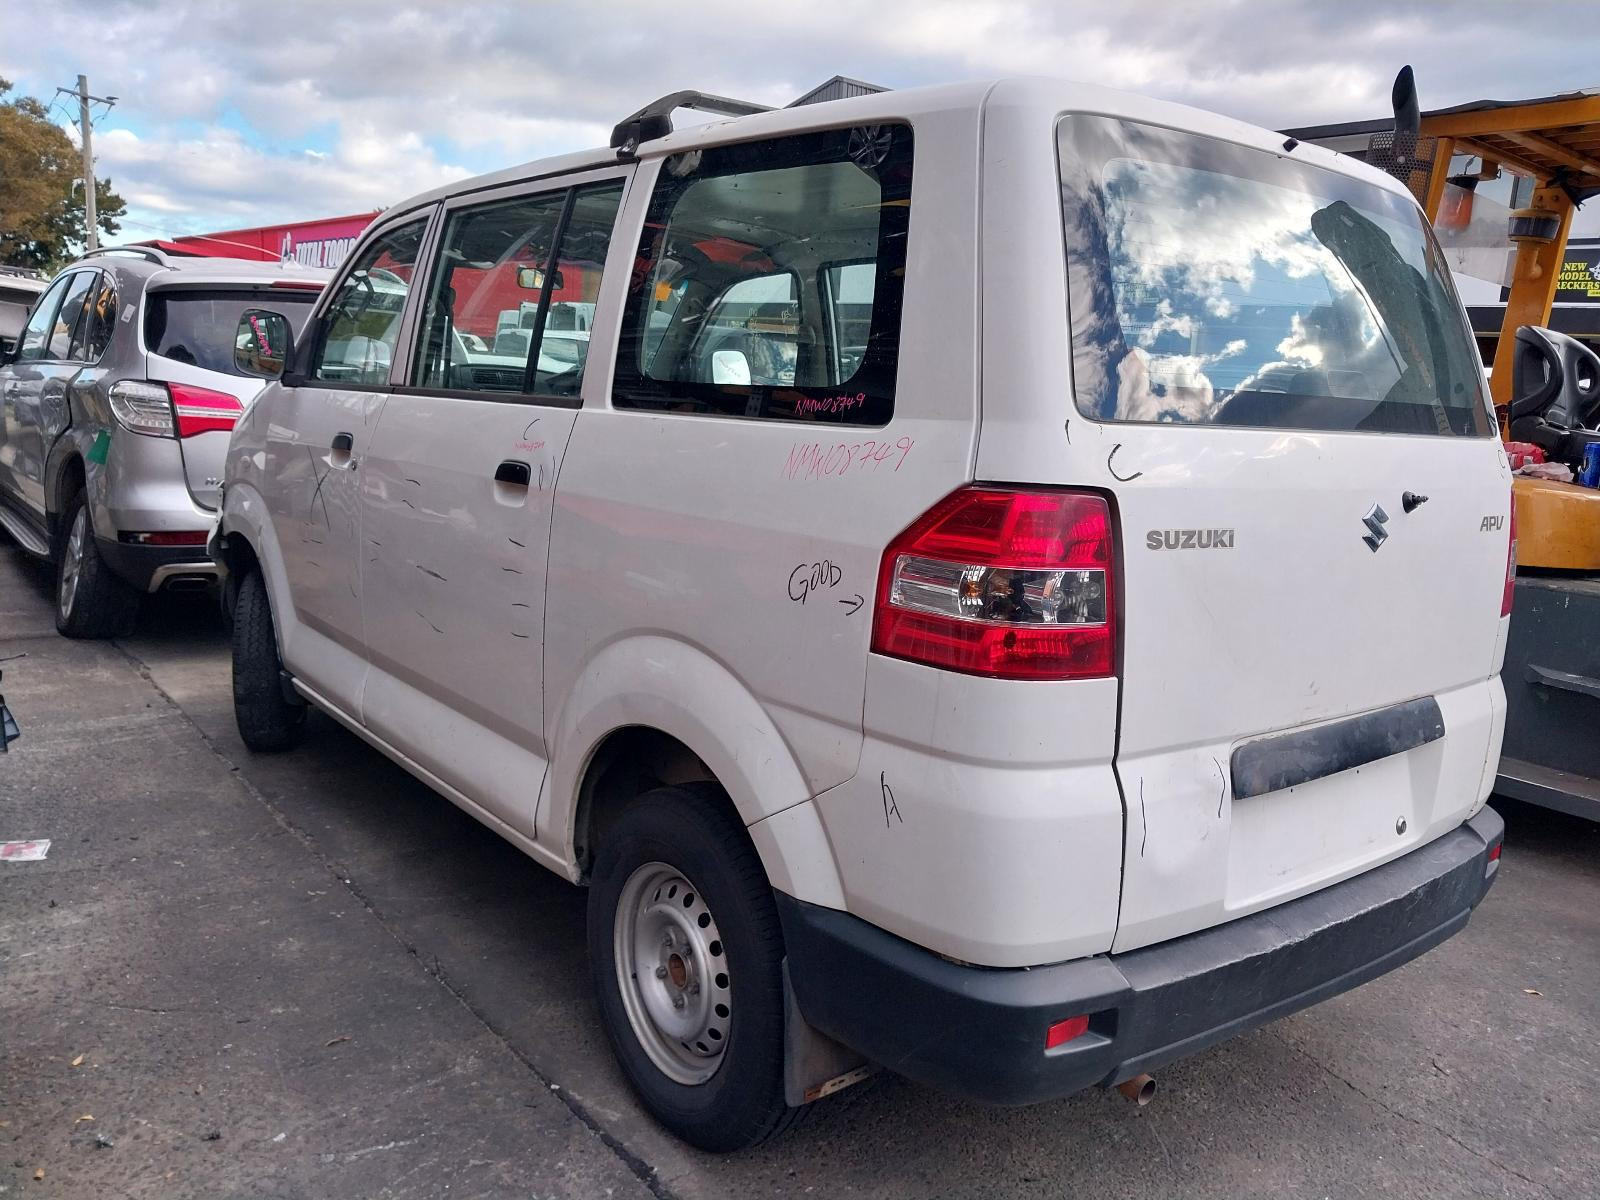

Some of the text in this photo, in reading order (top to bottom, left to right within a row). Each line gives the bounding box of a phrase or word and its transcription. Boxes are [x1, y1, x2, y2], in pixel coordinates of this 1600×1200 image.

[295, 240, 323, 268] TOTAL
[1564, 262, 1588, 271] NEW
[1479, 515, 1505, 532] APV
[1146, 529, 1235, 551] SUZUKI
[787, 559, 842, 605] GOOD
